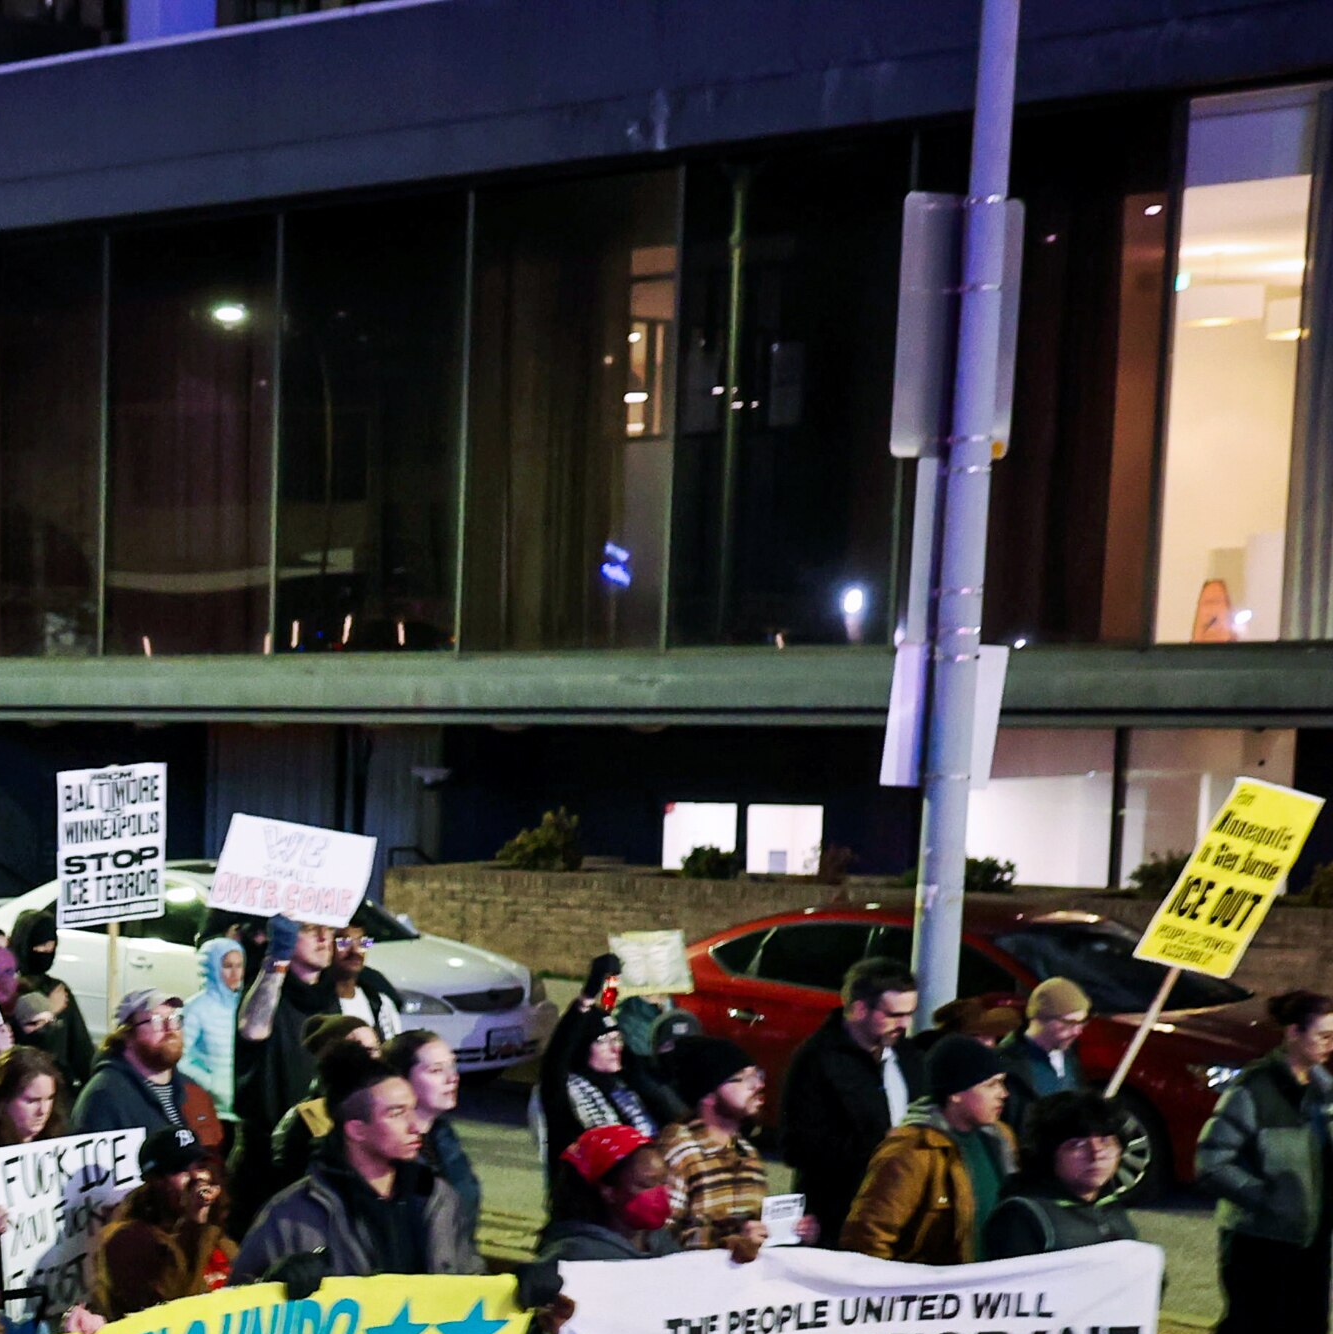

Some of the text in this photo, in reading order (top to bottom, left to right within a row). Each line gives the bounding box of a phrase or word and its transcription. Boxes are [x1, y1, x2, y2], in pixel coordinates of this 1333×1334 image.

[63, 774, 160, 812] BALTIMORE
[63, 810, 160, 845] MINNEAPOLIS
[263, 824, 330, 869] WE
[63, 846, 160, 875] STOP
[262, 863, 316, 884] SHALL
[62, 868, 160, 906] ICE TERROR
[1167, 874, 1264, 933] ICE OUT
[3, 1144, 73, 1207] FUCK
[6, 1208, 49, 1258] YOU
[839, 1293, 962, 1327] UNITED
[969, 1292, 1055, 1320] WILL
